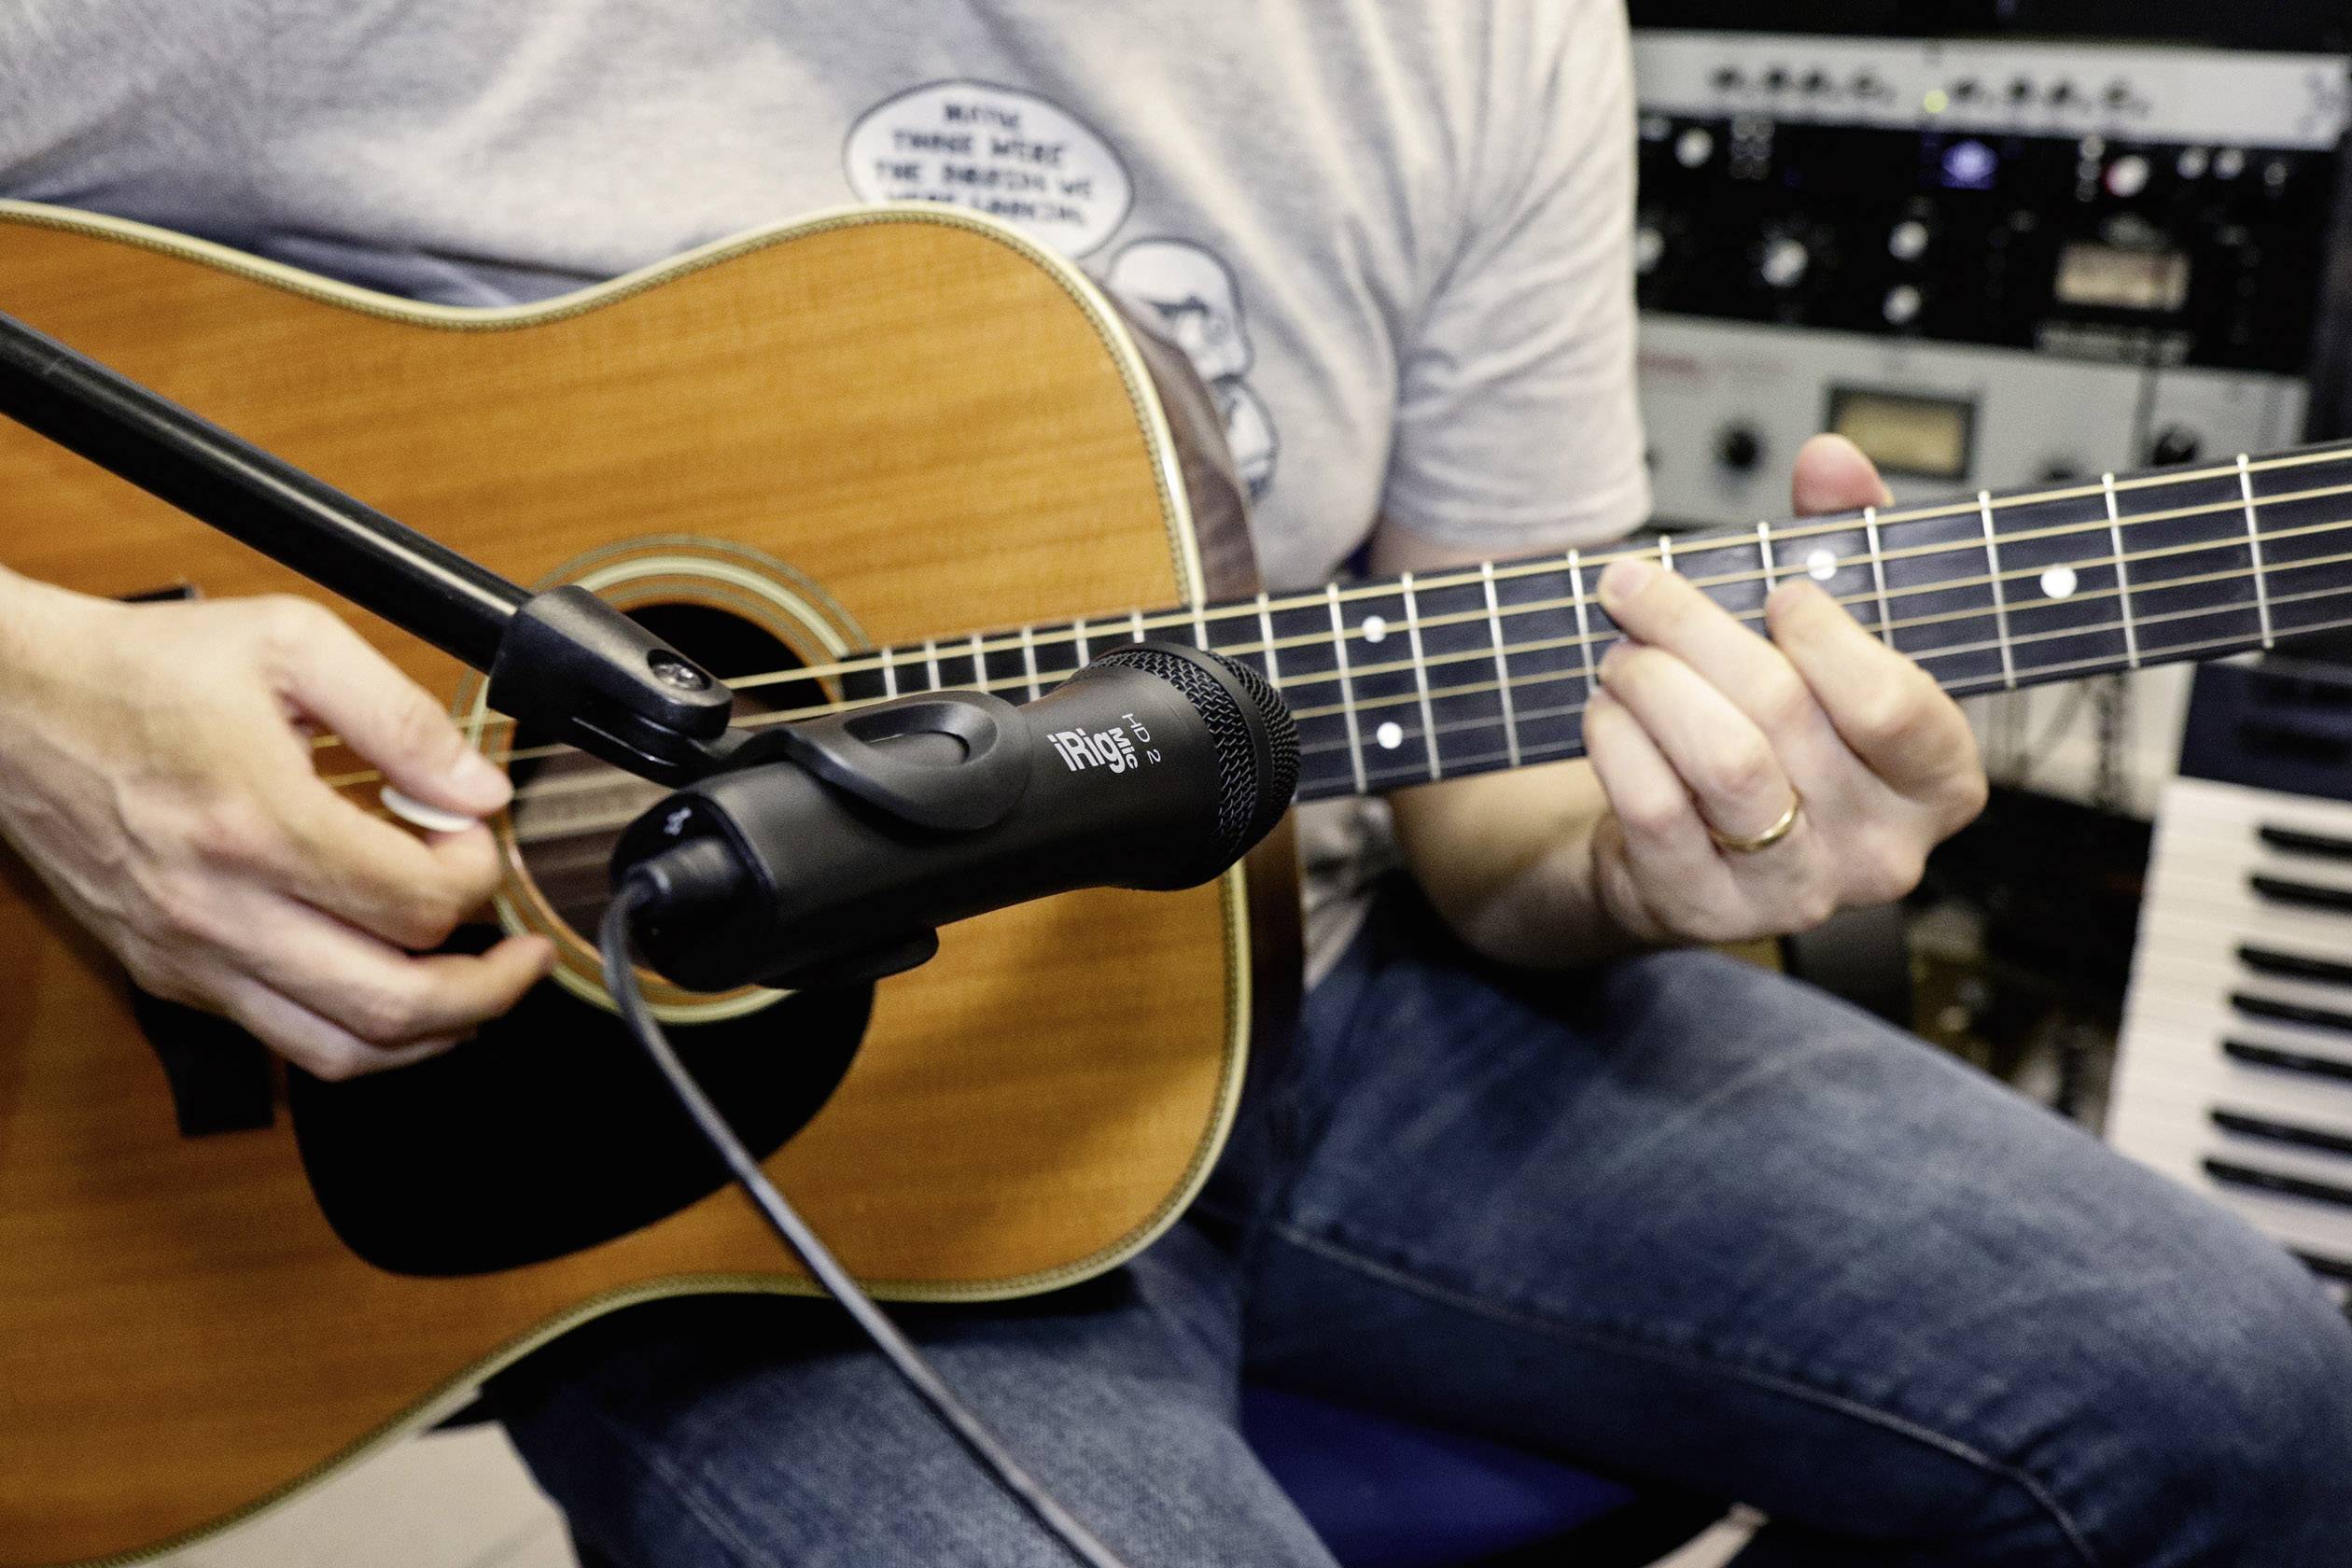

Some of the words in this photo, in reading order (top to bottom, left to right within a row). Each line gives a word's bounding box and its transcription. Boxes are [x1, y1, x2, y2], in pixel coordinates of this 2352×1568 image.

[1046, 727, 1126, 774] iRig
[1107, 727, 1139, 770] Mic
[1122, 713, 1151, 743] HD
[1147, 749, 1162, 764] 2
